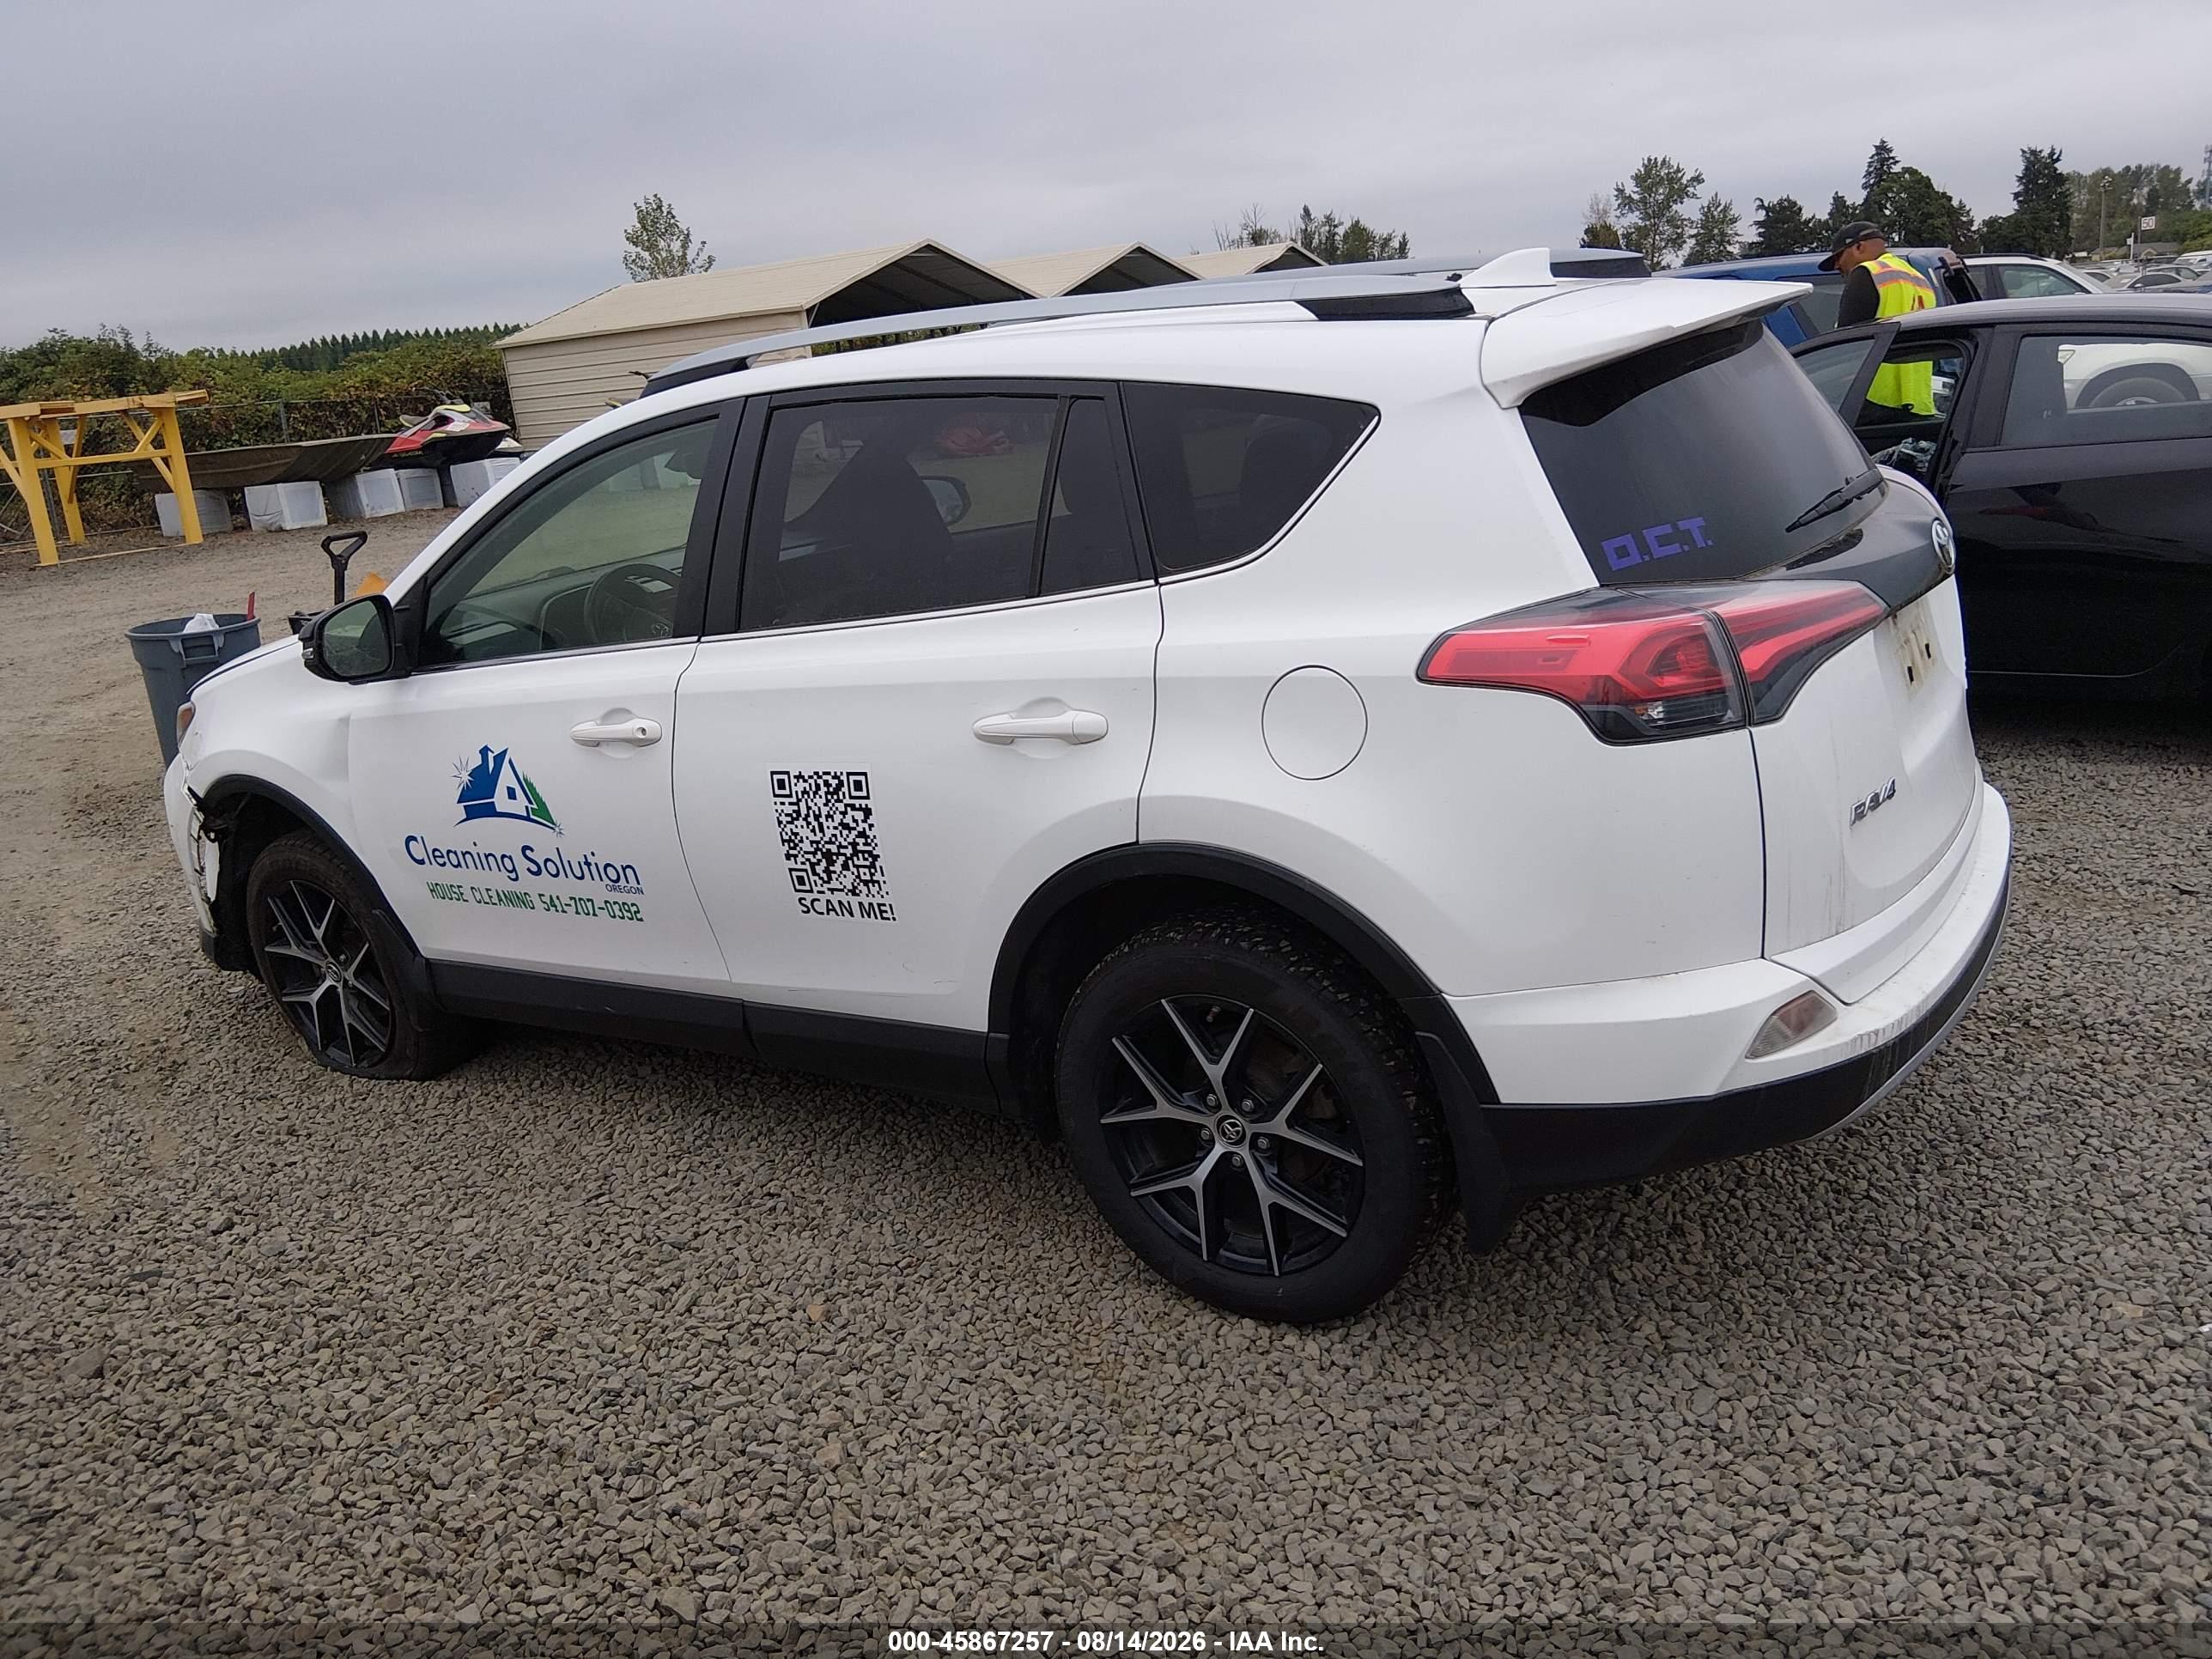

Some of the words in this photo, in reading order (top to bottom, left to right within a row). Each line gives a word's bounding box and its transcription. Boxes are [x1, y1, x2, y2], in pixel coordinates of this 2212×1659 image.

[1601, 516, 1714, 571] O.C.T.
[404, 835, 520, 883] Cleaning
[520, 844, 641, 887] Solution
[426, 881, 470, 903] HOUSE
[470, 885, 536, 910] CLEANING
[605, 883, 645, 896] OREGON
[797, 896, 855, 918] SCAN
[857, 901, 897, 922] ME!
